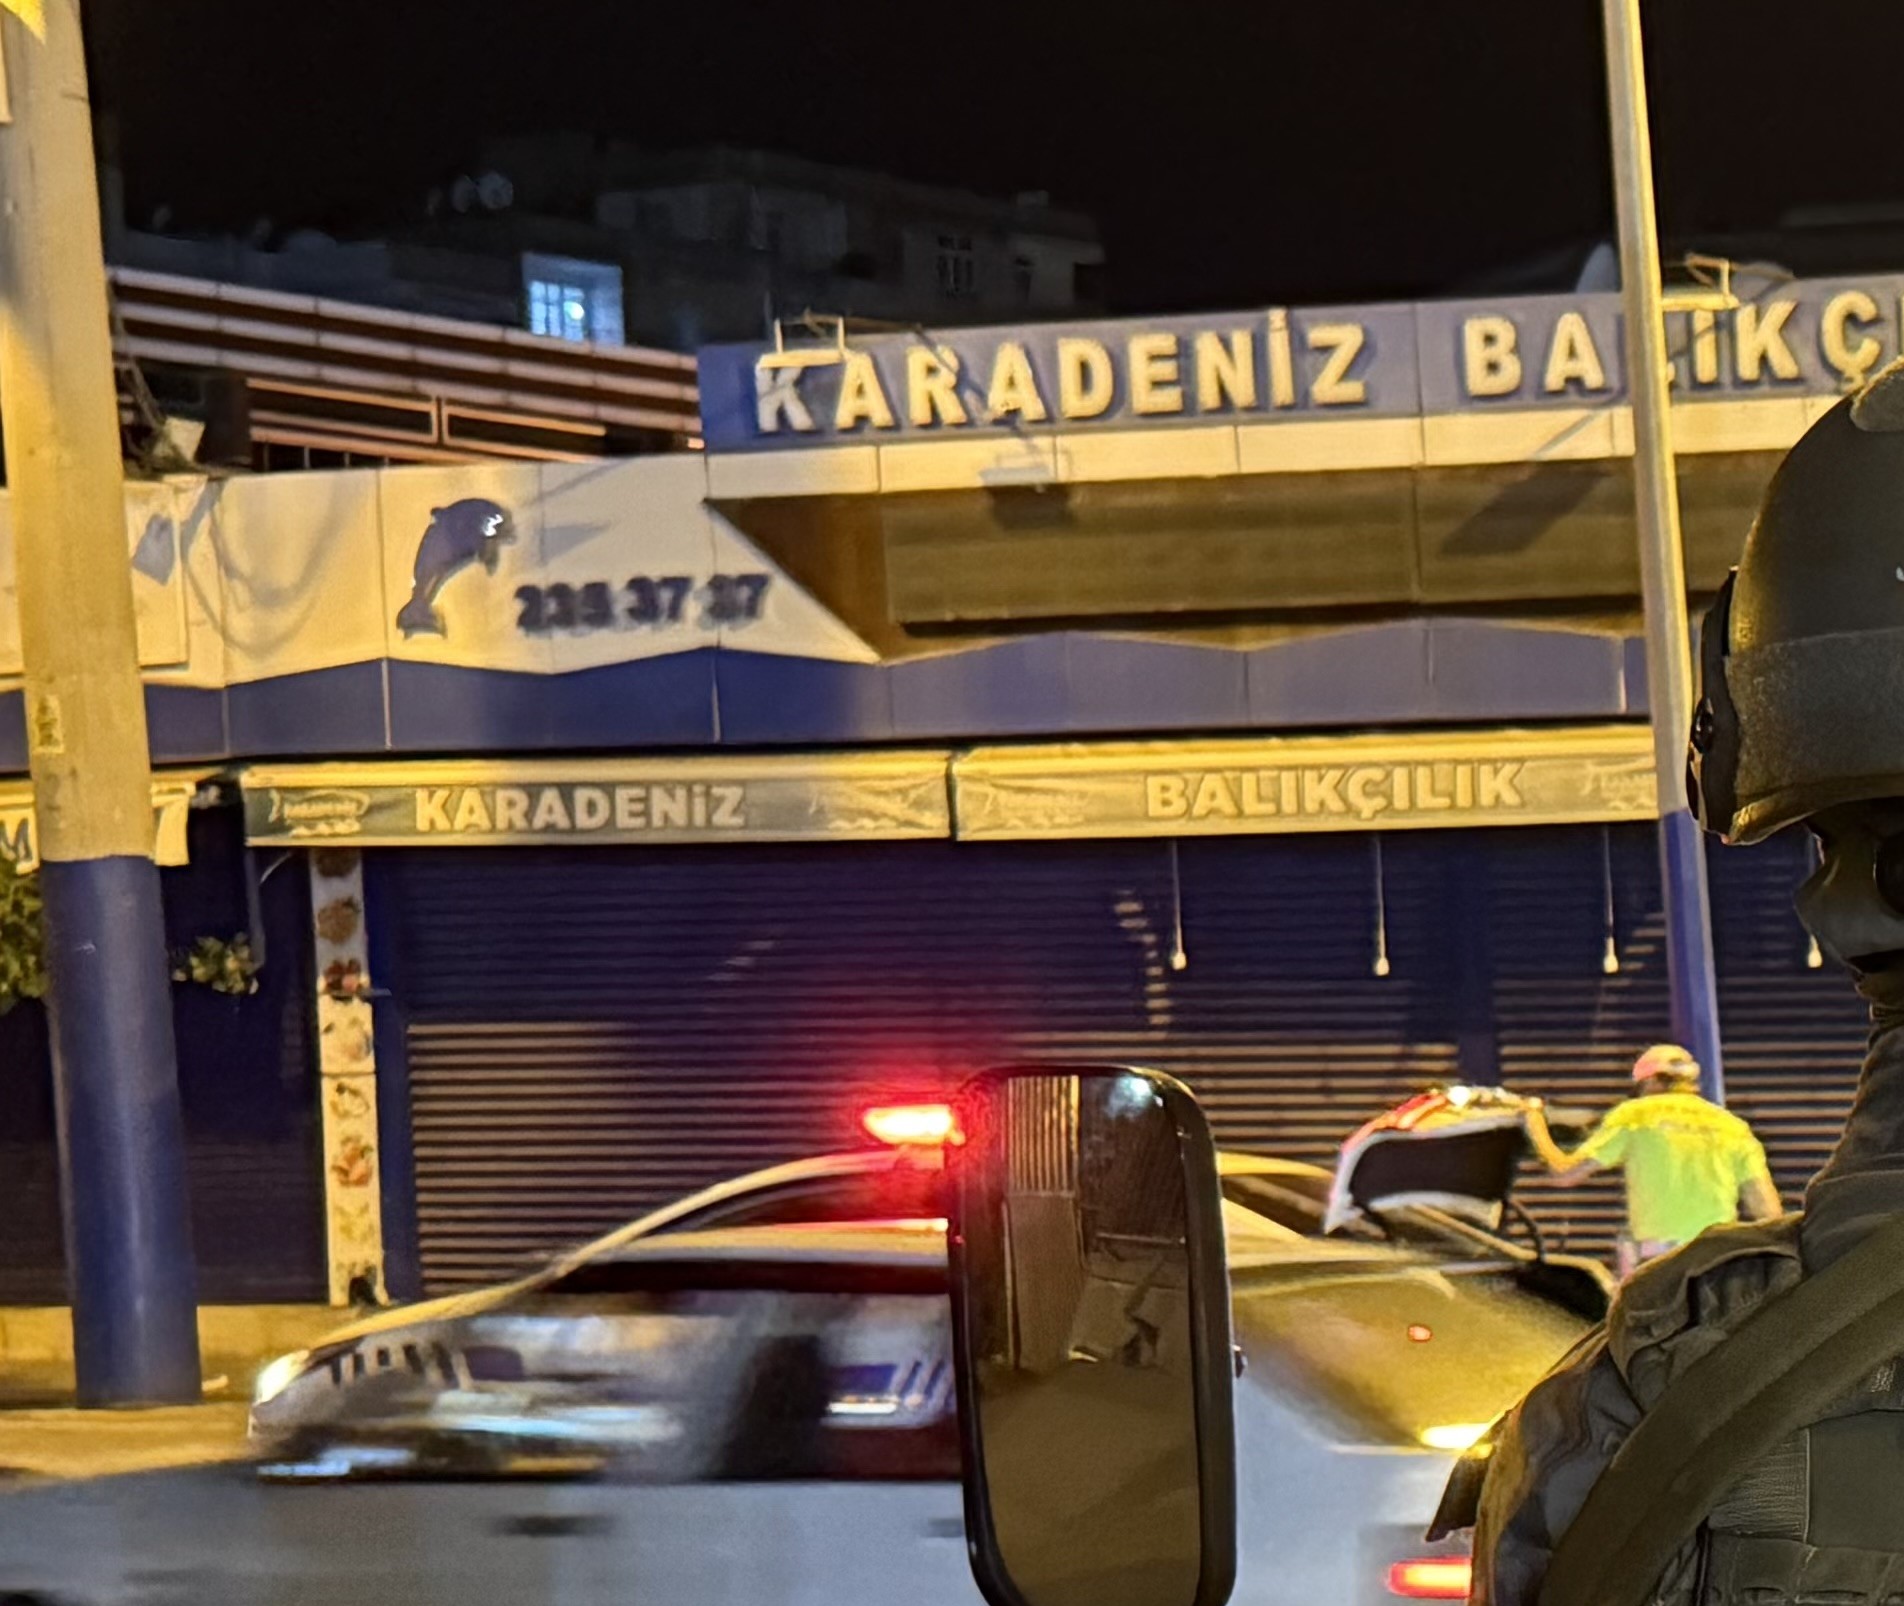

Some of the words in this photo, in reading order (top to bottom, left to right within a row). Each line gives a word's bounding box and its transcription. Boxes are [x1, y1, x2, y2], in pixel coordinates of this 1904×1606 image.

[755, 308, 1368, 432] KARADENİZ
[626, 575, 693, 624] 37
[1145, 760, 1526, 820] BALIKÇILIK
